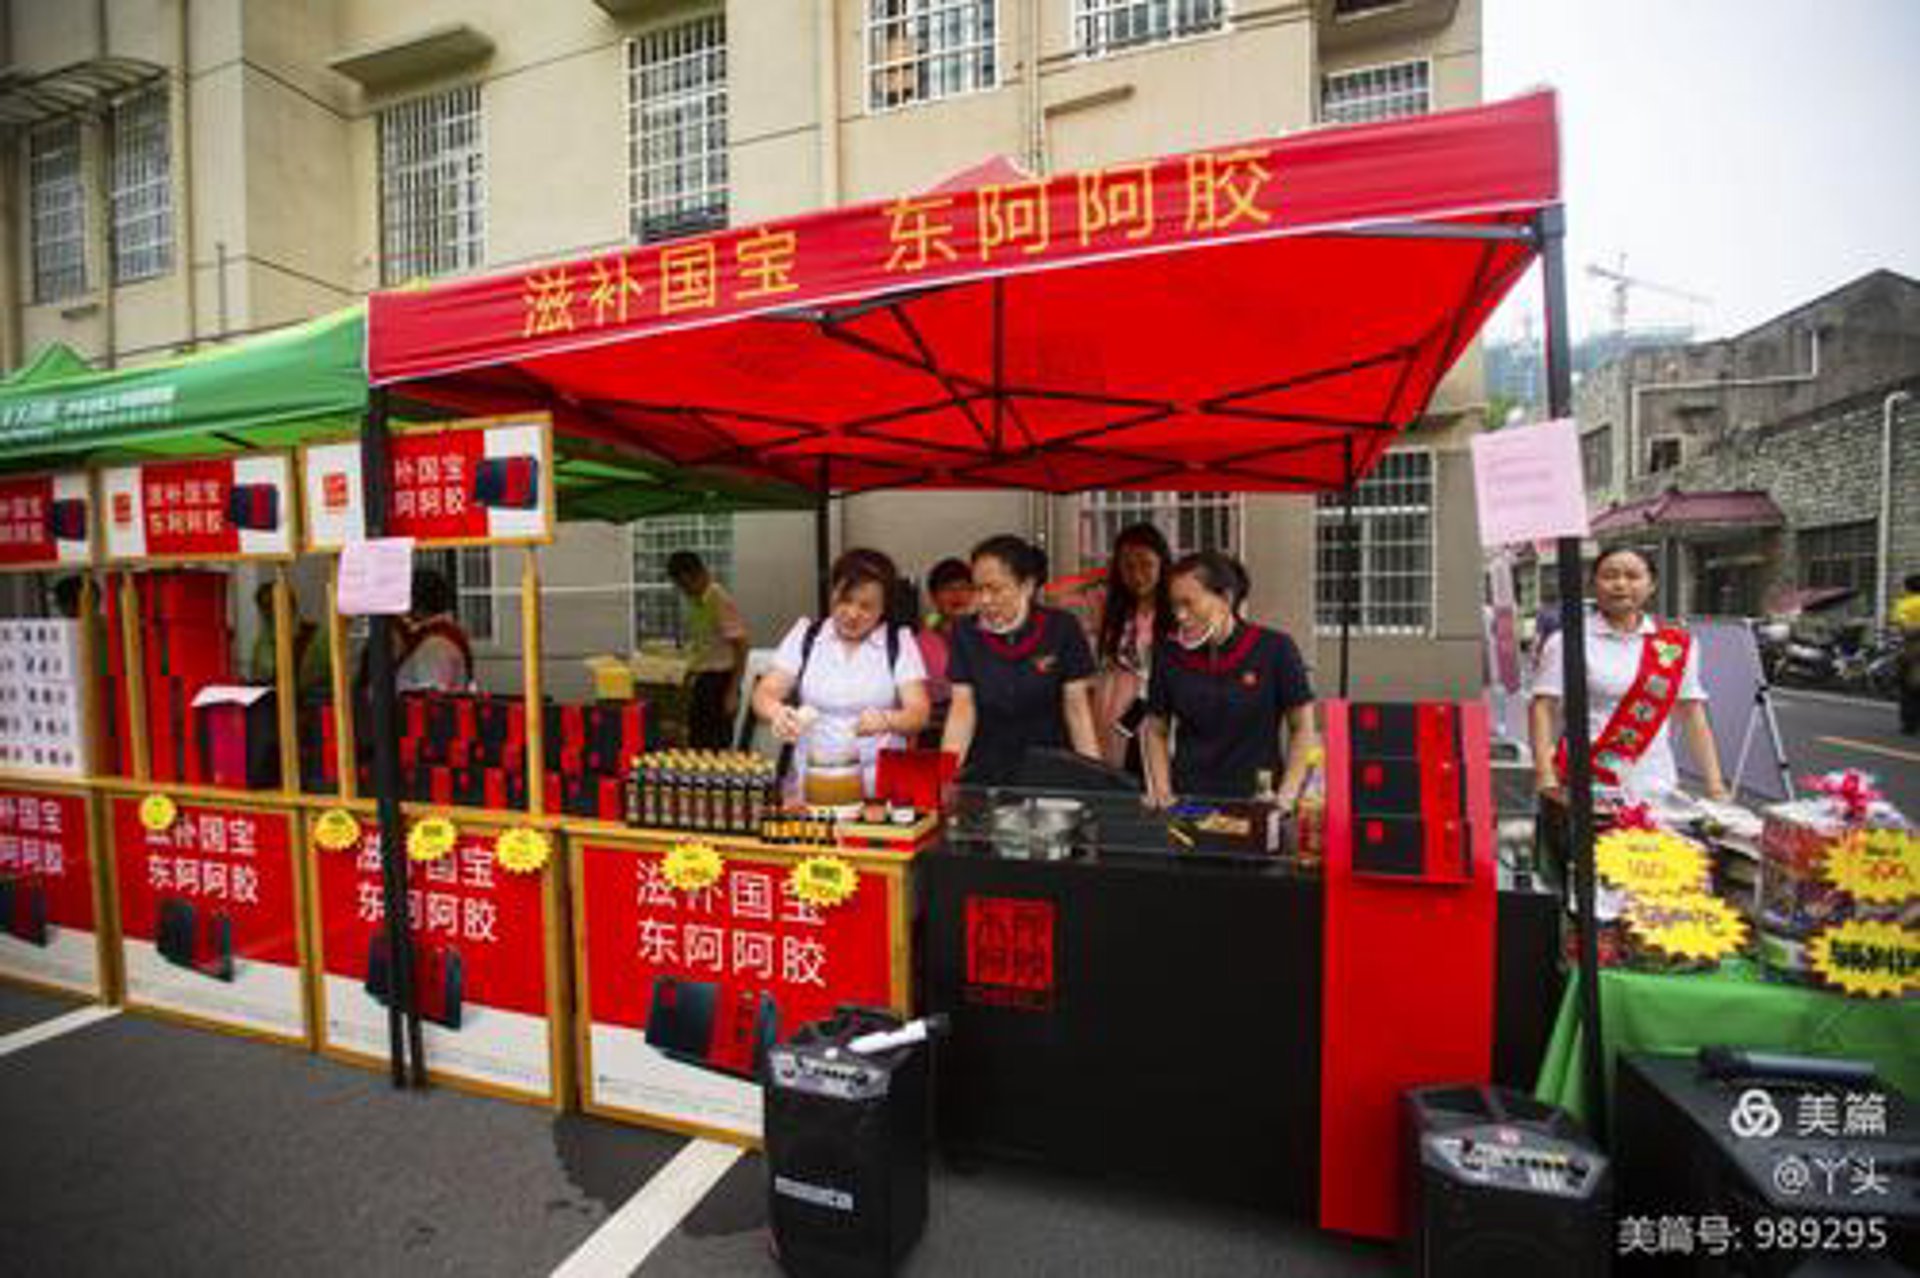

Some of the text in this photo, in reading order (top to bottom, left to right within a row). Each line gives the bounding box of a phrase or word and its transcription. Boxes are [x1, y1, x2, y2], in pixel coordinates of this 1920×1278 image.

[521, 148, 1273, 338] 滋补国宝 东阿阿胶
[394, 452, 466, 485] 补国宝
[394, 486, 466, 518] 阿阿胶
[148, 855, 258, 904] 东阿阿胶
[356, 832, 495, 889] 滋国宝
[636, 916, 827, 987] 东阿阿胶
